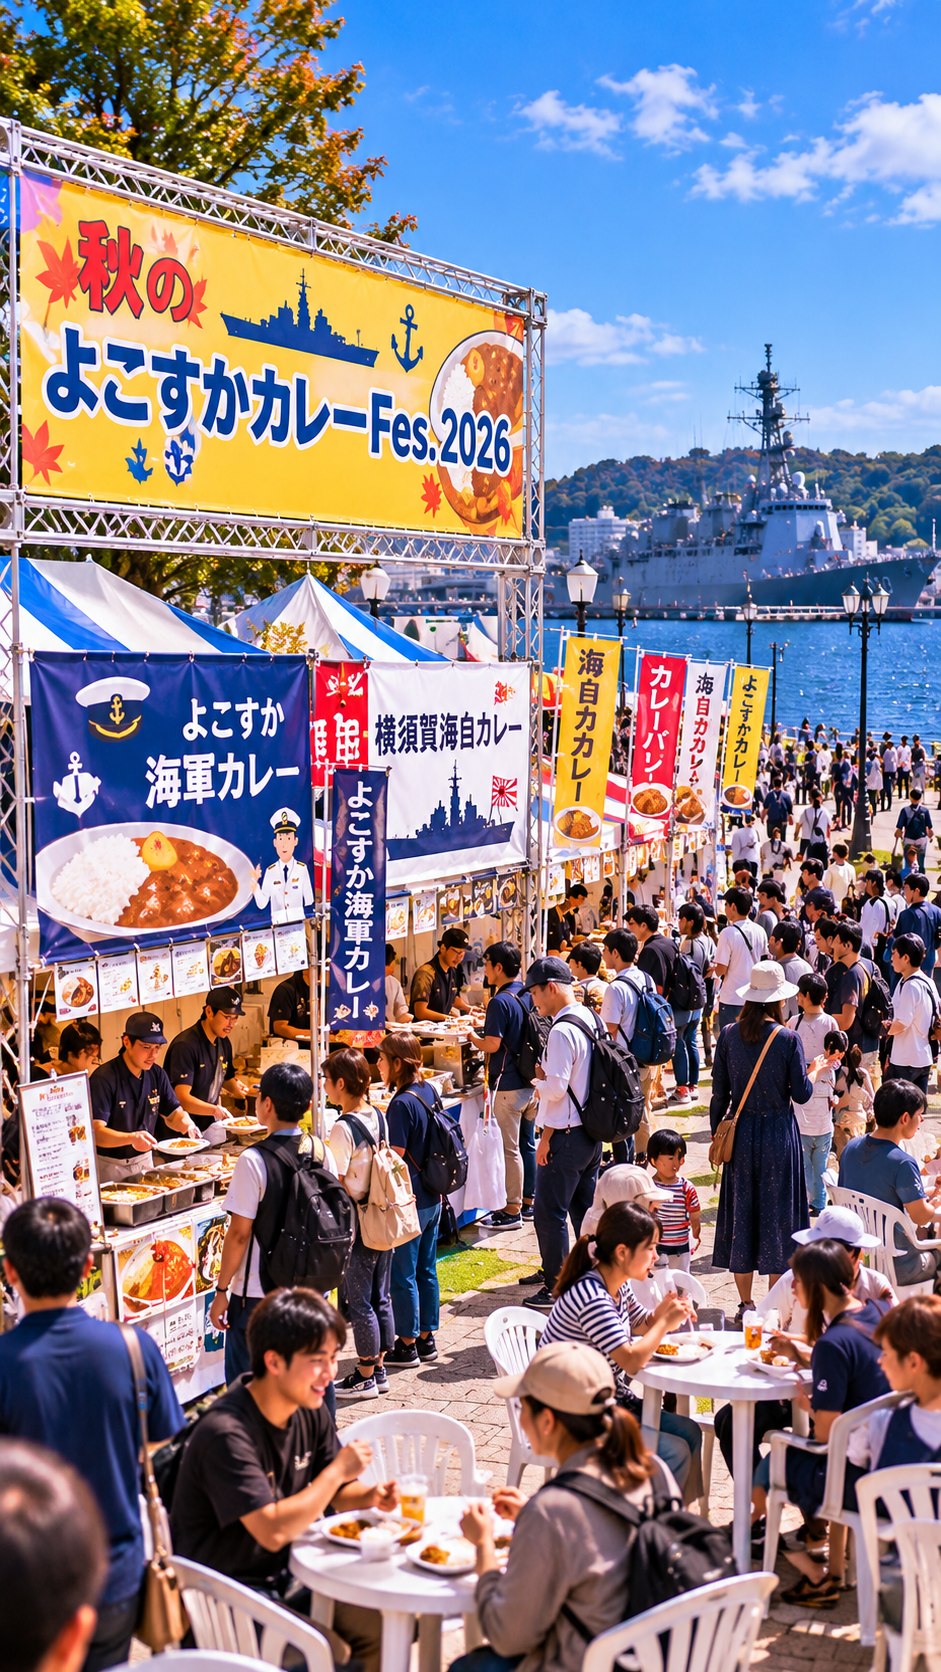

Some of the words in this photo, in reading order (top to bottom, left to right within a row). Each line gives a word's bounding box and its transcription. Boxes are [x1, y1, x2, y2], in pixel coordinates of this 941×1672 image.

[78, 220, 194, 323] 秋の
[182, 696, 285, 742] よこすか
[374, 711, 523, 757] 横須賀海自カレー
[733, 675, 758, 782] よこすかカレー
[145, 752, 300, 810] 海軍カレー
[343, 781, 374, 1019] よこすか海軍カレー
